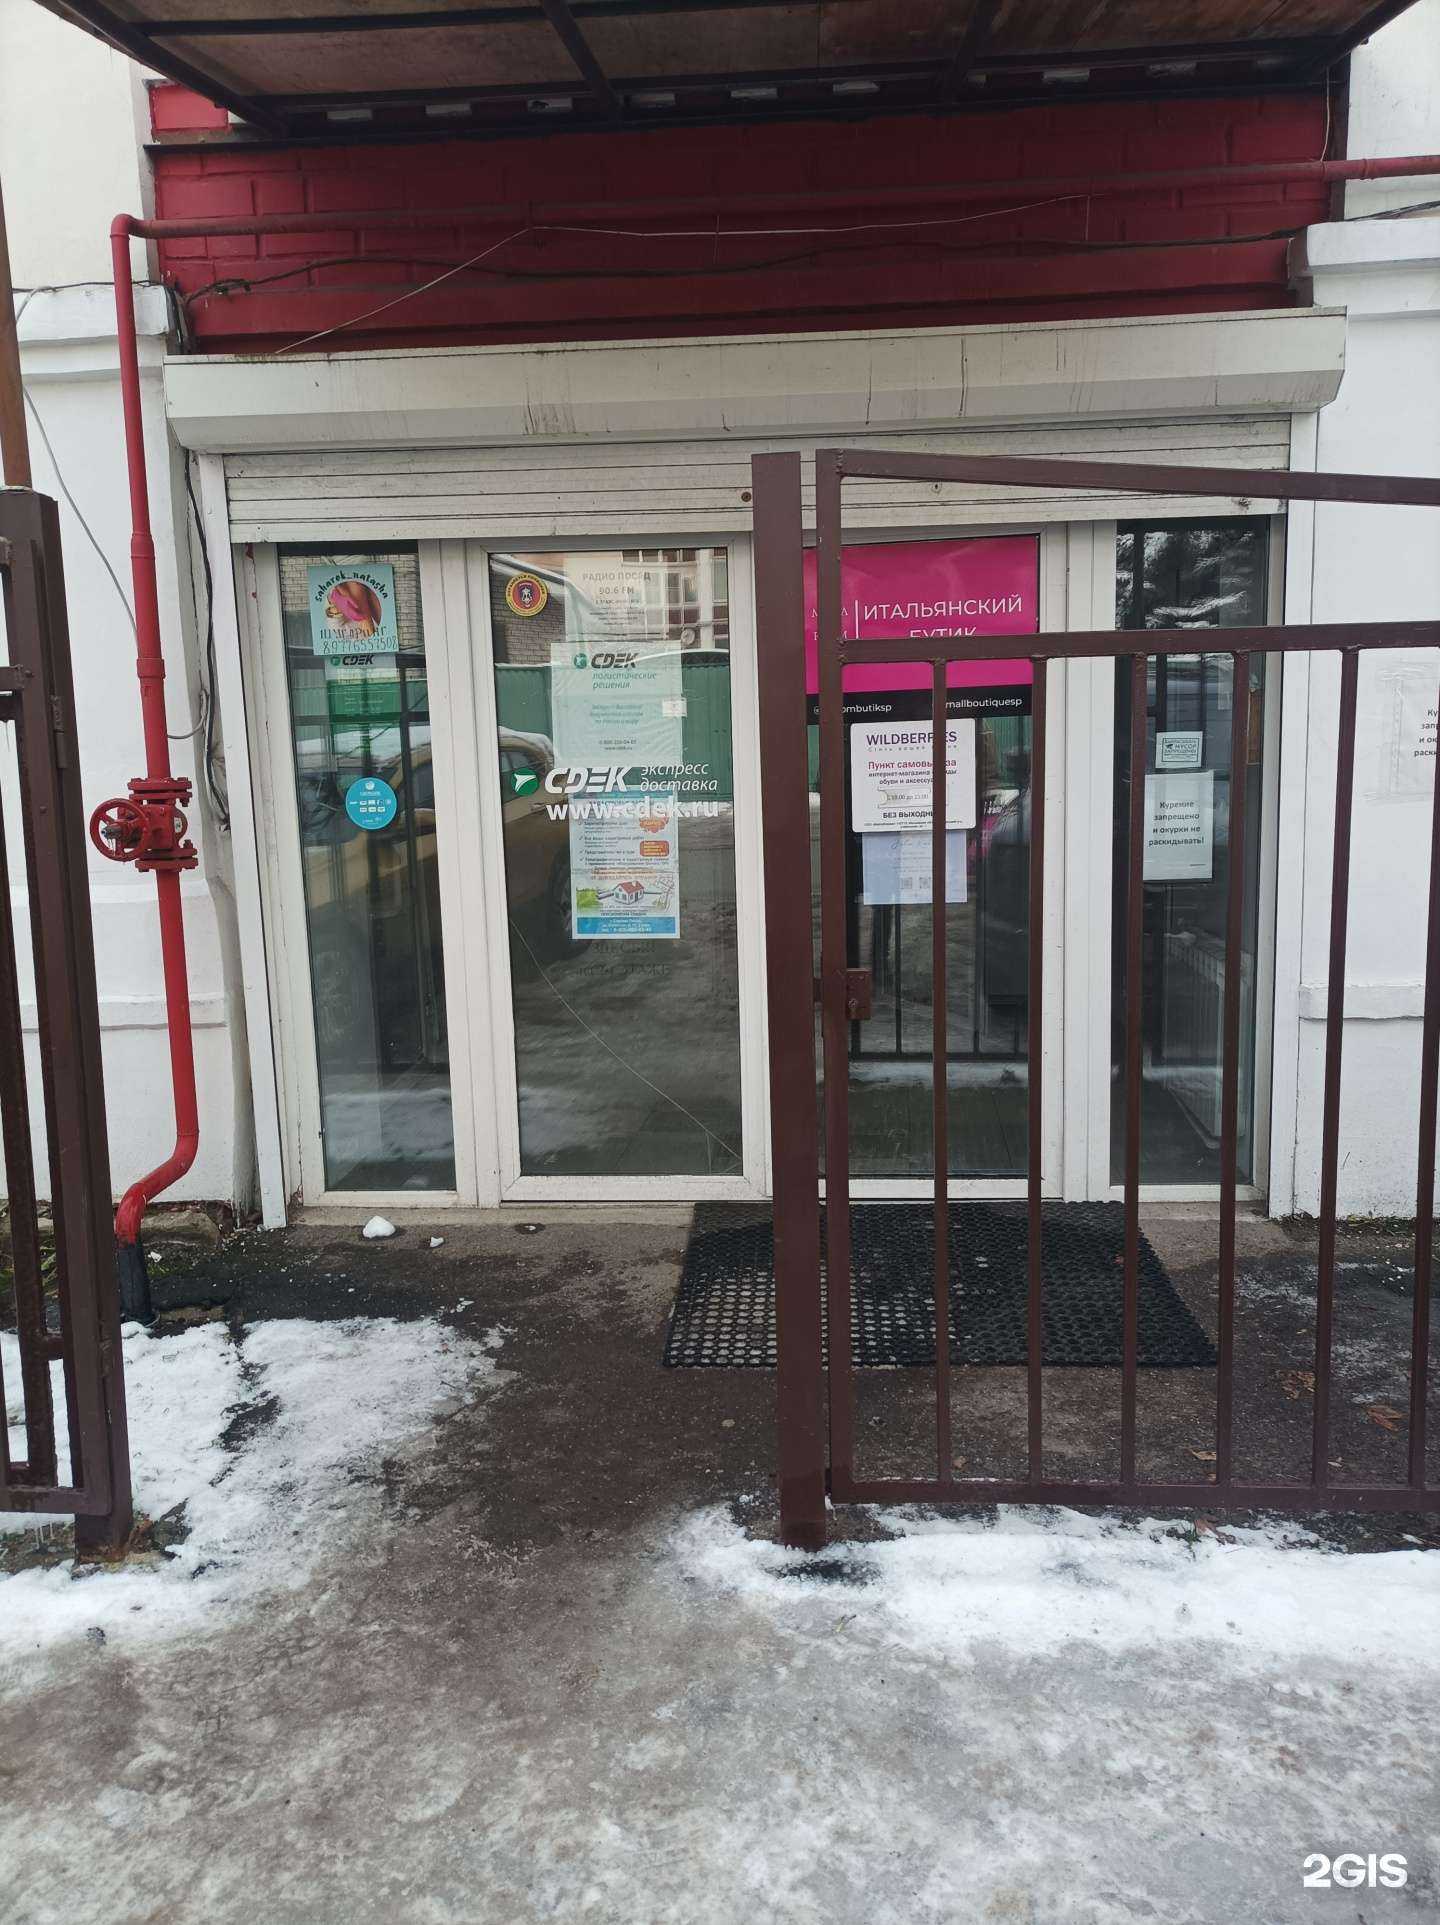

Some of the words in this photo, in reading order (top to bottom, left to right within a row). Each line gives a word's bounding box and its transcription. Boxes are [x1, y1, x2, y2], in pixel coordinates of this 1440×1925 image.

[864, 594, 1022, 621] ИТАЛЬЯНСКИЙ
[342, 654, 375, 666] CDEK
[590, 653, 639, 669] CDEK
[866, 731, 957, 746] WILDBERRS
[641, 762, 709, 777] экспресс
[868, 761, 895, 771] Пункт
[544, 767, 632, 794] CDEK
[640, 776, 718, 793] доставка
[546, 796, 719, 821] www.cdek.ru
[1159, 801, 1195, 809] Курение
[883, 811, 897, 819] БЕЗ
[1153, 813, 1200, 822] запрещено
[1160, 826, 1189, 834] окурки
[1148, 837, 1204, 847] раскидывать!
